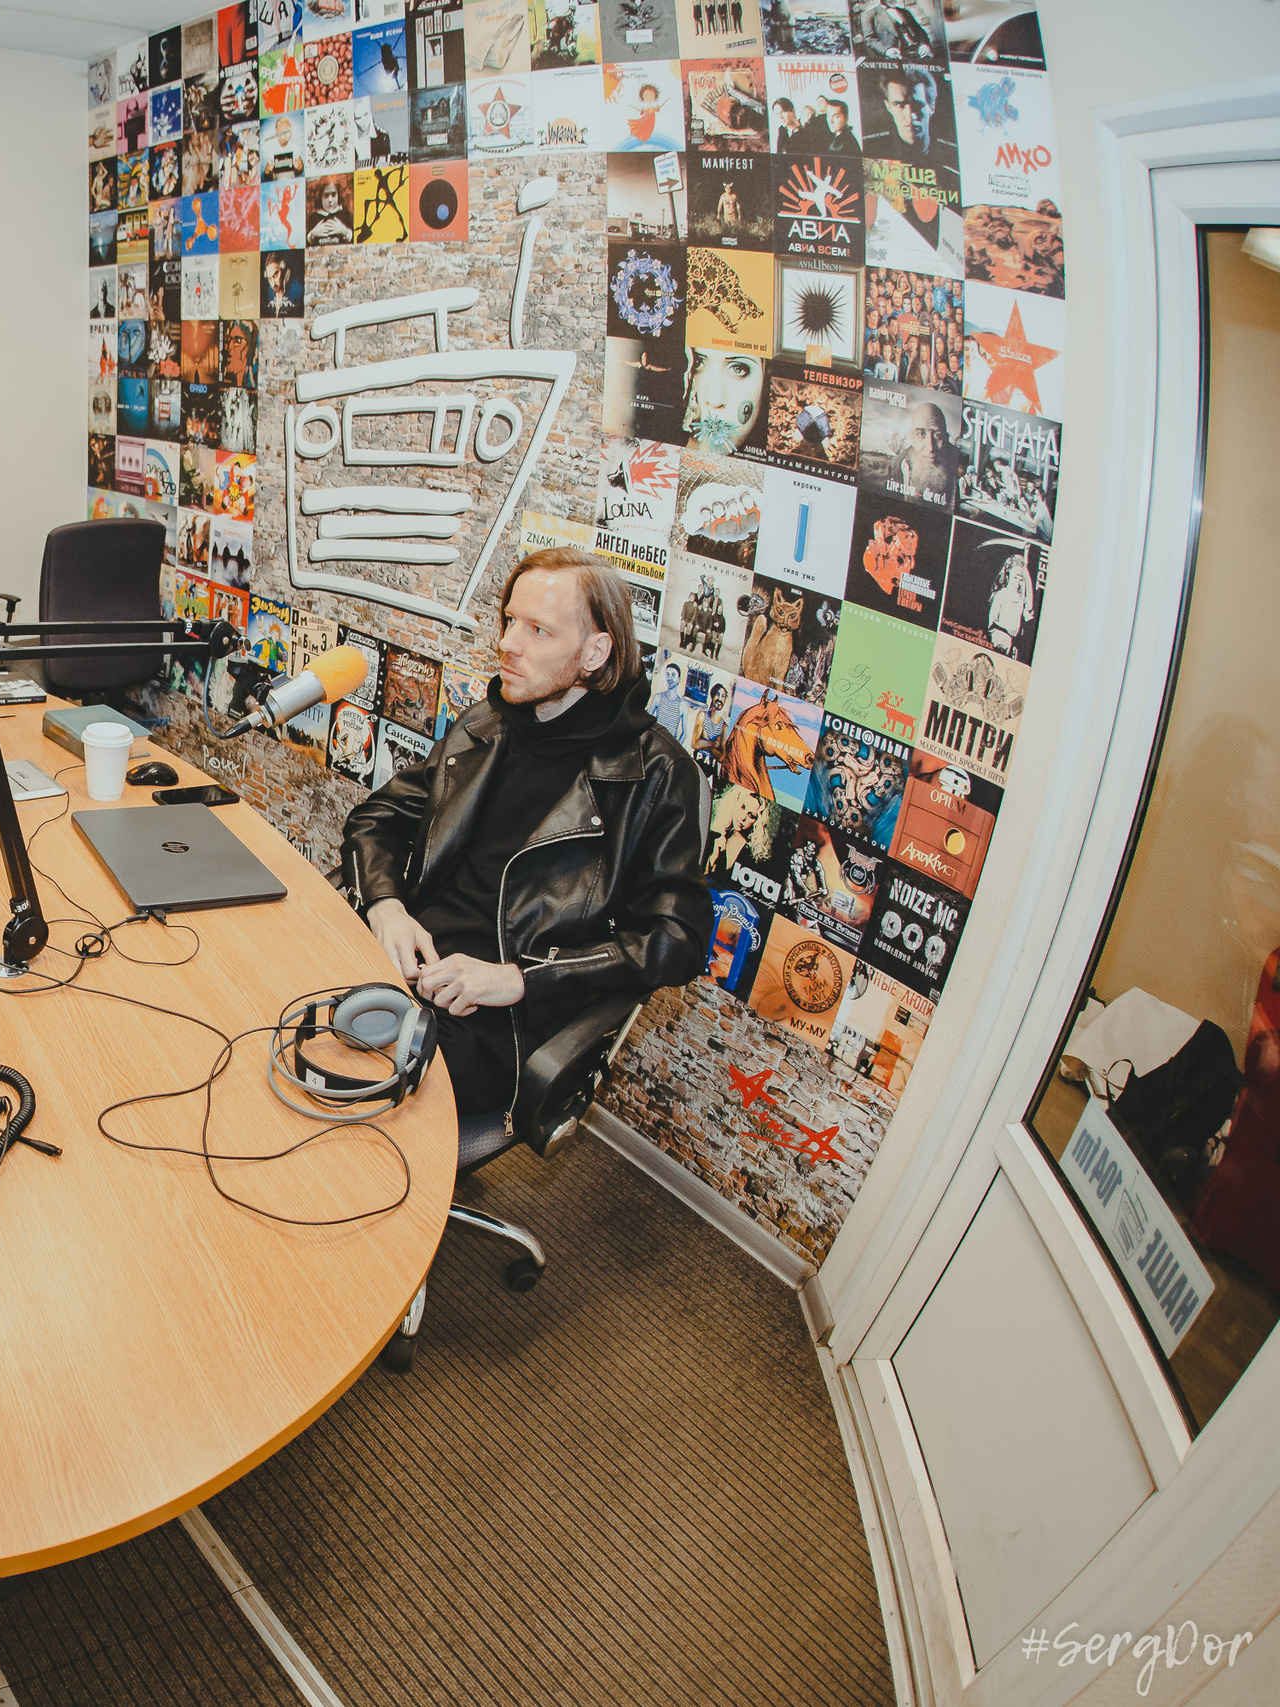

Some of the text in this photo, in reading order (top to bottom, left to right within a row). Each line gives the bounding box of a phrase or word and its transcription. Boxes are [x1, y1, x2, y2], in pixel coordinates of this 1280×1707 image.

[416, 14, 452, 35] КИНО
[702, 157, 754, 171] MANIFEST
[995, 142, 1052, 175] ЛИХО
[886, 182, 959, 205] медведи
[788, 220, 851, 243] АВИА
[788, 243, 850, 257] АВИА ВСЕМ!
[803, 370, 863, 390] ТЕЛЕВИЗОР
[743, 445, 767, 457] ЛИНДА
[793, 480, 822, 492] кирпичи
[595, 532, 629, 555] АНГЕЛ
[636, 563, 665, 581] альбом
[783, 567, 816, 582] сила ума
[342, 709, 365, 725] РАКЕТЫ
[384, 722, 427, 751] Сансара
[923, 699, 1015, 773] МПТРИ
[766, 736, 805, 760] ЛОШАДКА
[959, 755, 987, 777] БРОСИЛ
[930, 789, 967, 816] OPIUM
[888, 877, 959, 932] NOIZE MC
[787, 941, 821, 964] АНСАМБЛЬ
[802, 979, 830, 997] ТАЙМ
[811, 989, 828, 1003] АУТ
[900, 990, 935, 1018] ЛЮДИ
[789, 1016, 827, 1039] МУ-МУ
